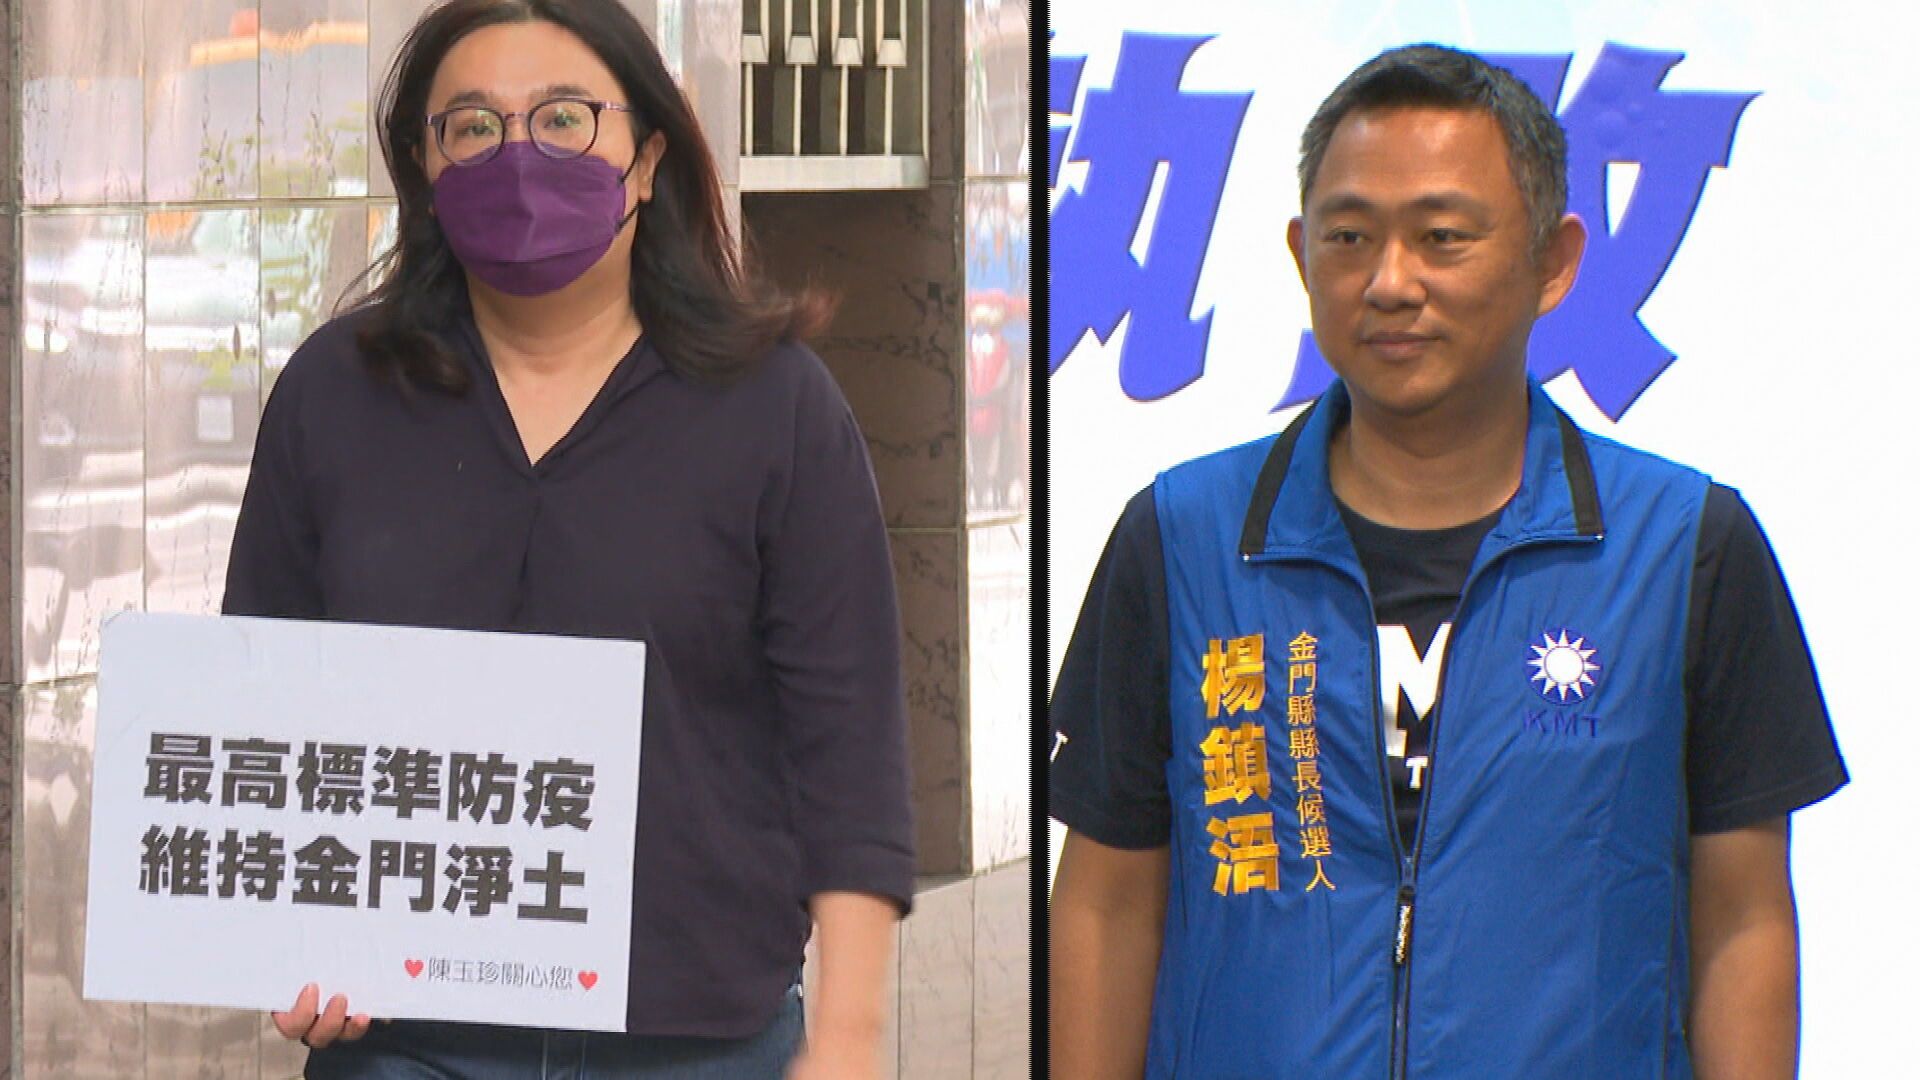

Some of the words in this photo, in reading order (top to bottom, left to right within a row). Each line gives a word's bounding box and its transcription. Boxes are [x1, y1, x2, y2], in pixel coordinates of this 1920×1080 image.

[1199, 633, 1280, 897] 楊鎮浯
[1287, 631, 1336, 892] 金門縣縣長候選人
[1523, 709, 1602, 738] KMT
[143, 731, 596, 831] 最高標準防疫
[139, 825, 588, 924] 維持金門淨土
[427, 957, 574, 990] 陳玉珍關心您
